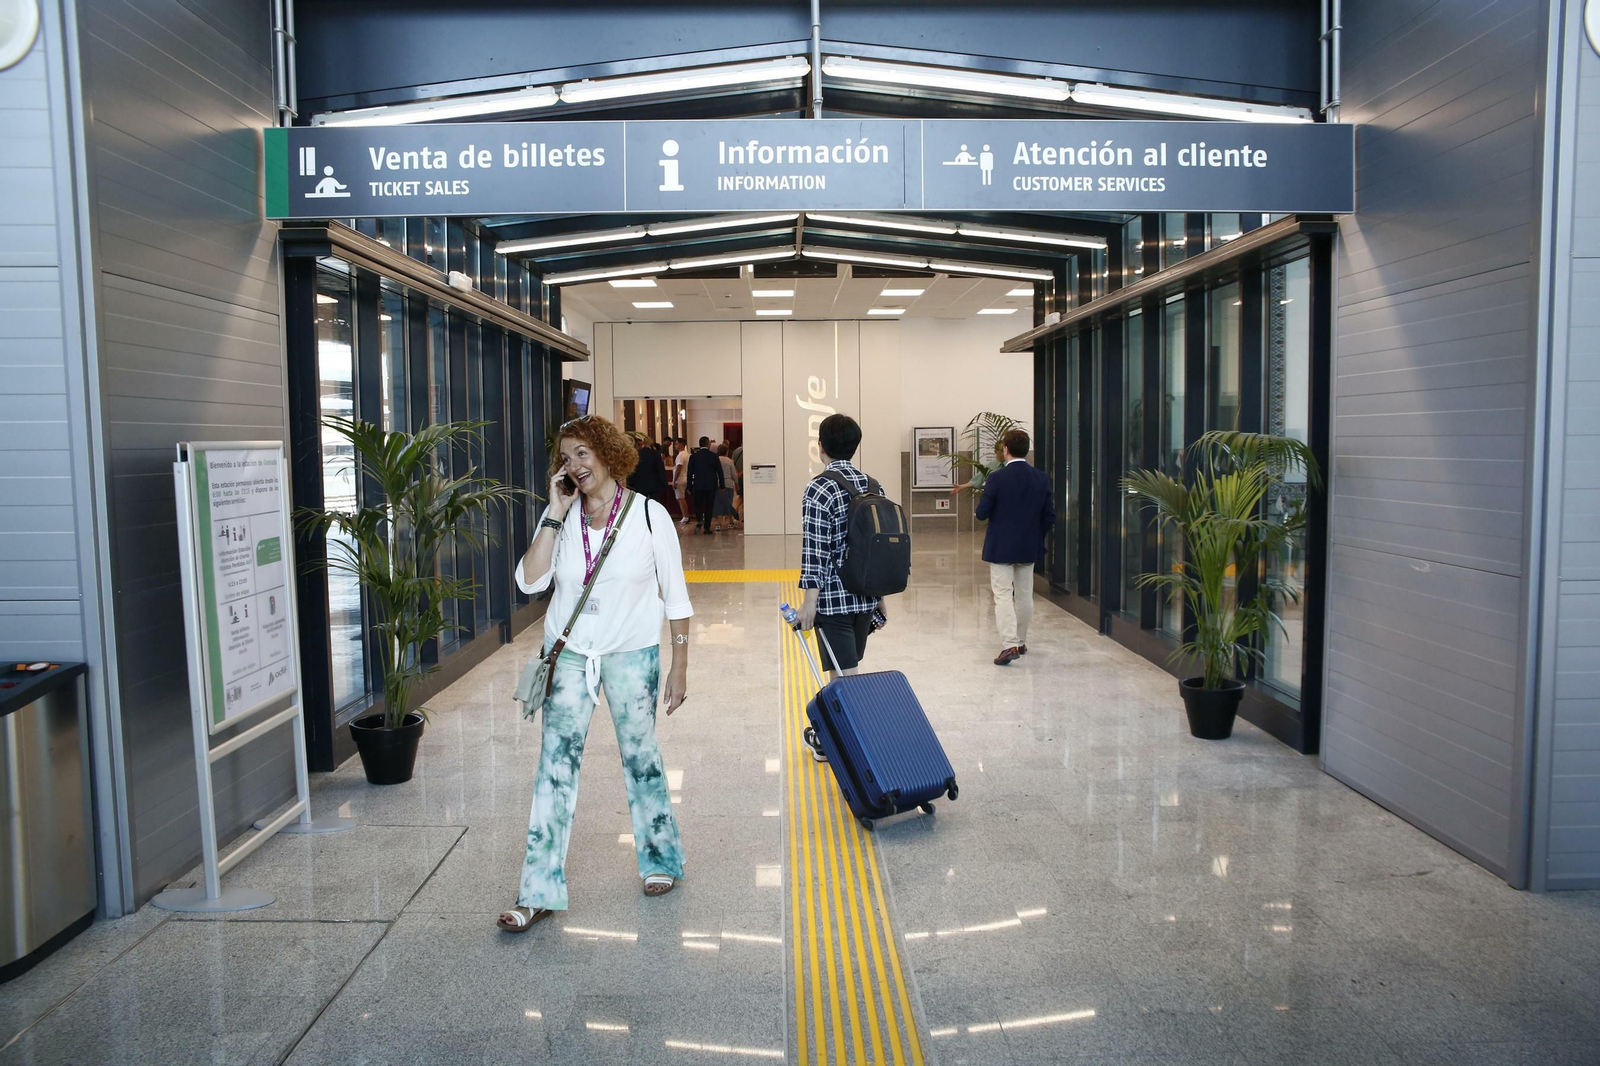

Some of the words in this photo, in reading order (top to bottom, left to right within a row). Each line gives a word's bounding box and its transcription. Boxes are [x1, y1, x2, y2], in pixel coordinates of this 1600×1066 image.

[369, 147, 448, 170] Venta
[459, 145, 492, 168] de
[504, 143, 605, 168] billetes
[719, 138, 889, 164] Información
[1012, 140, 1132, 166] Atención
[1143, 142, 1166, 166] al
[1178, 142, 1268, 167] cliente
[369, 182, 421, 196] TICKET
[425, 180, 470, 196] SALES
[718, 175, 826, 190] INFORMATION
[1012, 176, 1093, 191] CUSTOMER
[1097, 177, 1166, 192] SERVICES
[210, 461, 232, 469] Bienvenido
